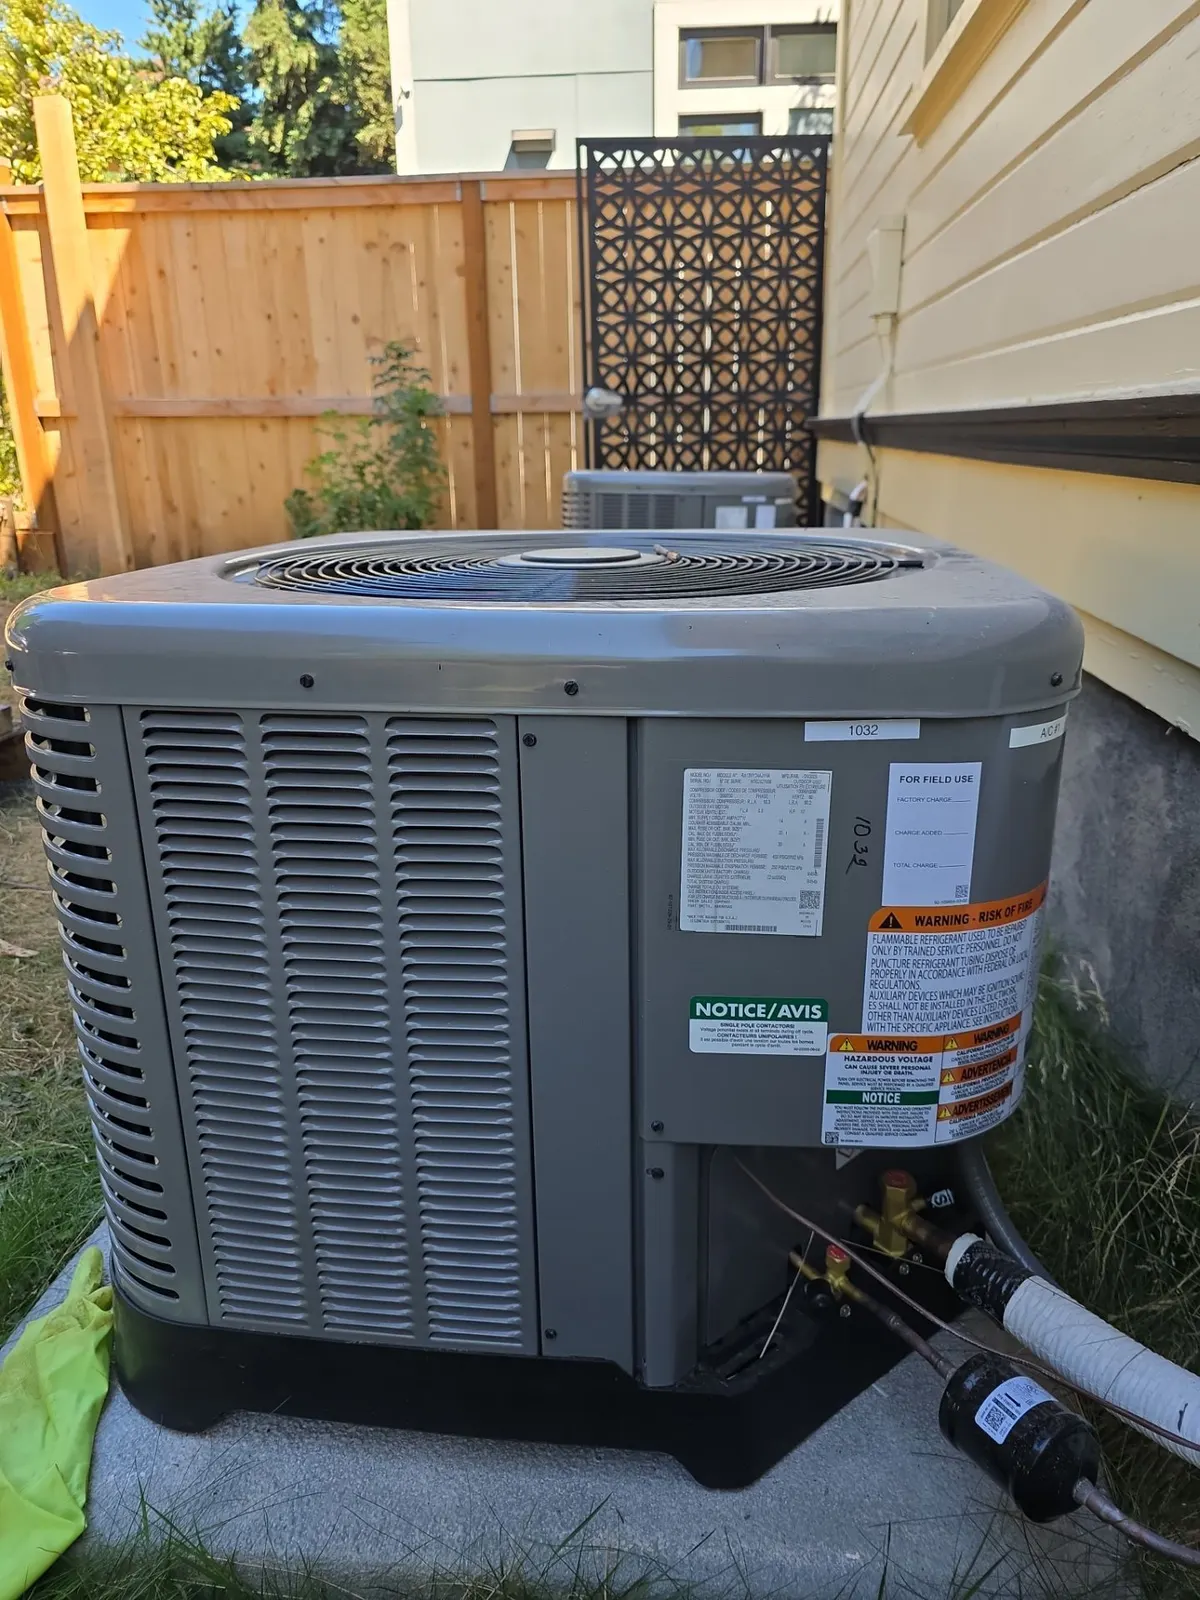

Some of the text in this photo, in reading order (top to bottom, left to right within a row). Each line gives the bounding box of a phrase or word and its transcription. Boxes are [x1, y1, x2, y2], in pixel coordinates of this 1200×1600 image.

[849, 724, 879, 736] 1032
[900, 774, 974, 783] FOR FIELD USE
[915, 914, 969, 927] WARNING
[978, 910, 1003, 923] RISK
[1004, 904, 1016, 918] OF
[1017, 899, 1033, 914] FIRE
[873, 934, 918, 944] FLAMMABLE
[920, 933, 967, 944] REFRIGERANT
[987, 928, 997, 939] TO
[872, 945, 892, 955] ONLY
[893, 946, 903, 955] BY
[904, 945, 936, 956] TRAINED
[937, 944, 965, 956] SERVICE
[870, 969, 907, 979] PROPERLY
[908, 970, 917, 979] IN
[918, 967, 966, 979] ACCORDANCE
[967, 964, 983, 976] WITH
[984, 958, 1008, 973] FEDERAL
[871, 958, 910, 968] PUNCTURE
[912, 957, 960, 968] REFRIGERANT
[869, 979, 922, 990] REGULATIONS.
[869, 990, 907, 1001] AUXILIARY
[908, 990, 938, 1001] DEVICES
[939, 988, 962, 1000] WHICH
[963, 986, 978, 997] MAY
[868, 1001, 878, 1010] ES
[879, 1001, 901, 1010] SHALL
[903, 1002, 919, 1011] NOT
[920, 1001, 929, 1010] BE
[930, 998, 965, 1010] INSTALLED
[966, 998, 973, 1006] IN
[974, 994, 986, 1005] THE
[696, 1002, 822, 1019] NOTICE/AVIS
[867, 1011, 892, 1021] OTHER
[893, 1012, 914, 1021] THAN
[915, 1010, 950, 1021] AUXILIARY
[951, 1006, 978, 1019] DEVICES
[978, 1001, 998, 1014] LISTED
[867, 1021, 886, 1032] WITH
[887, 1022, 902, 1032] THE
[903, 1021, 934, 1033] SPECIFIC
[972, 1015, 983, 1027] SEE
[866, 1039, 919, 1051] WARNING
[862, 1092, 901, 1104] NOTICE
